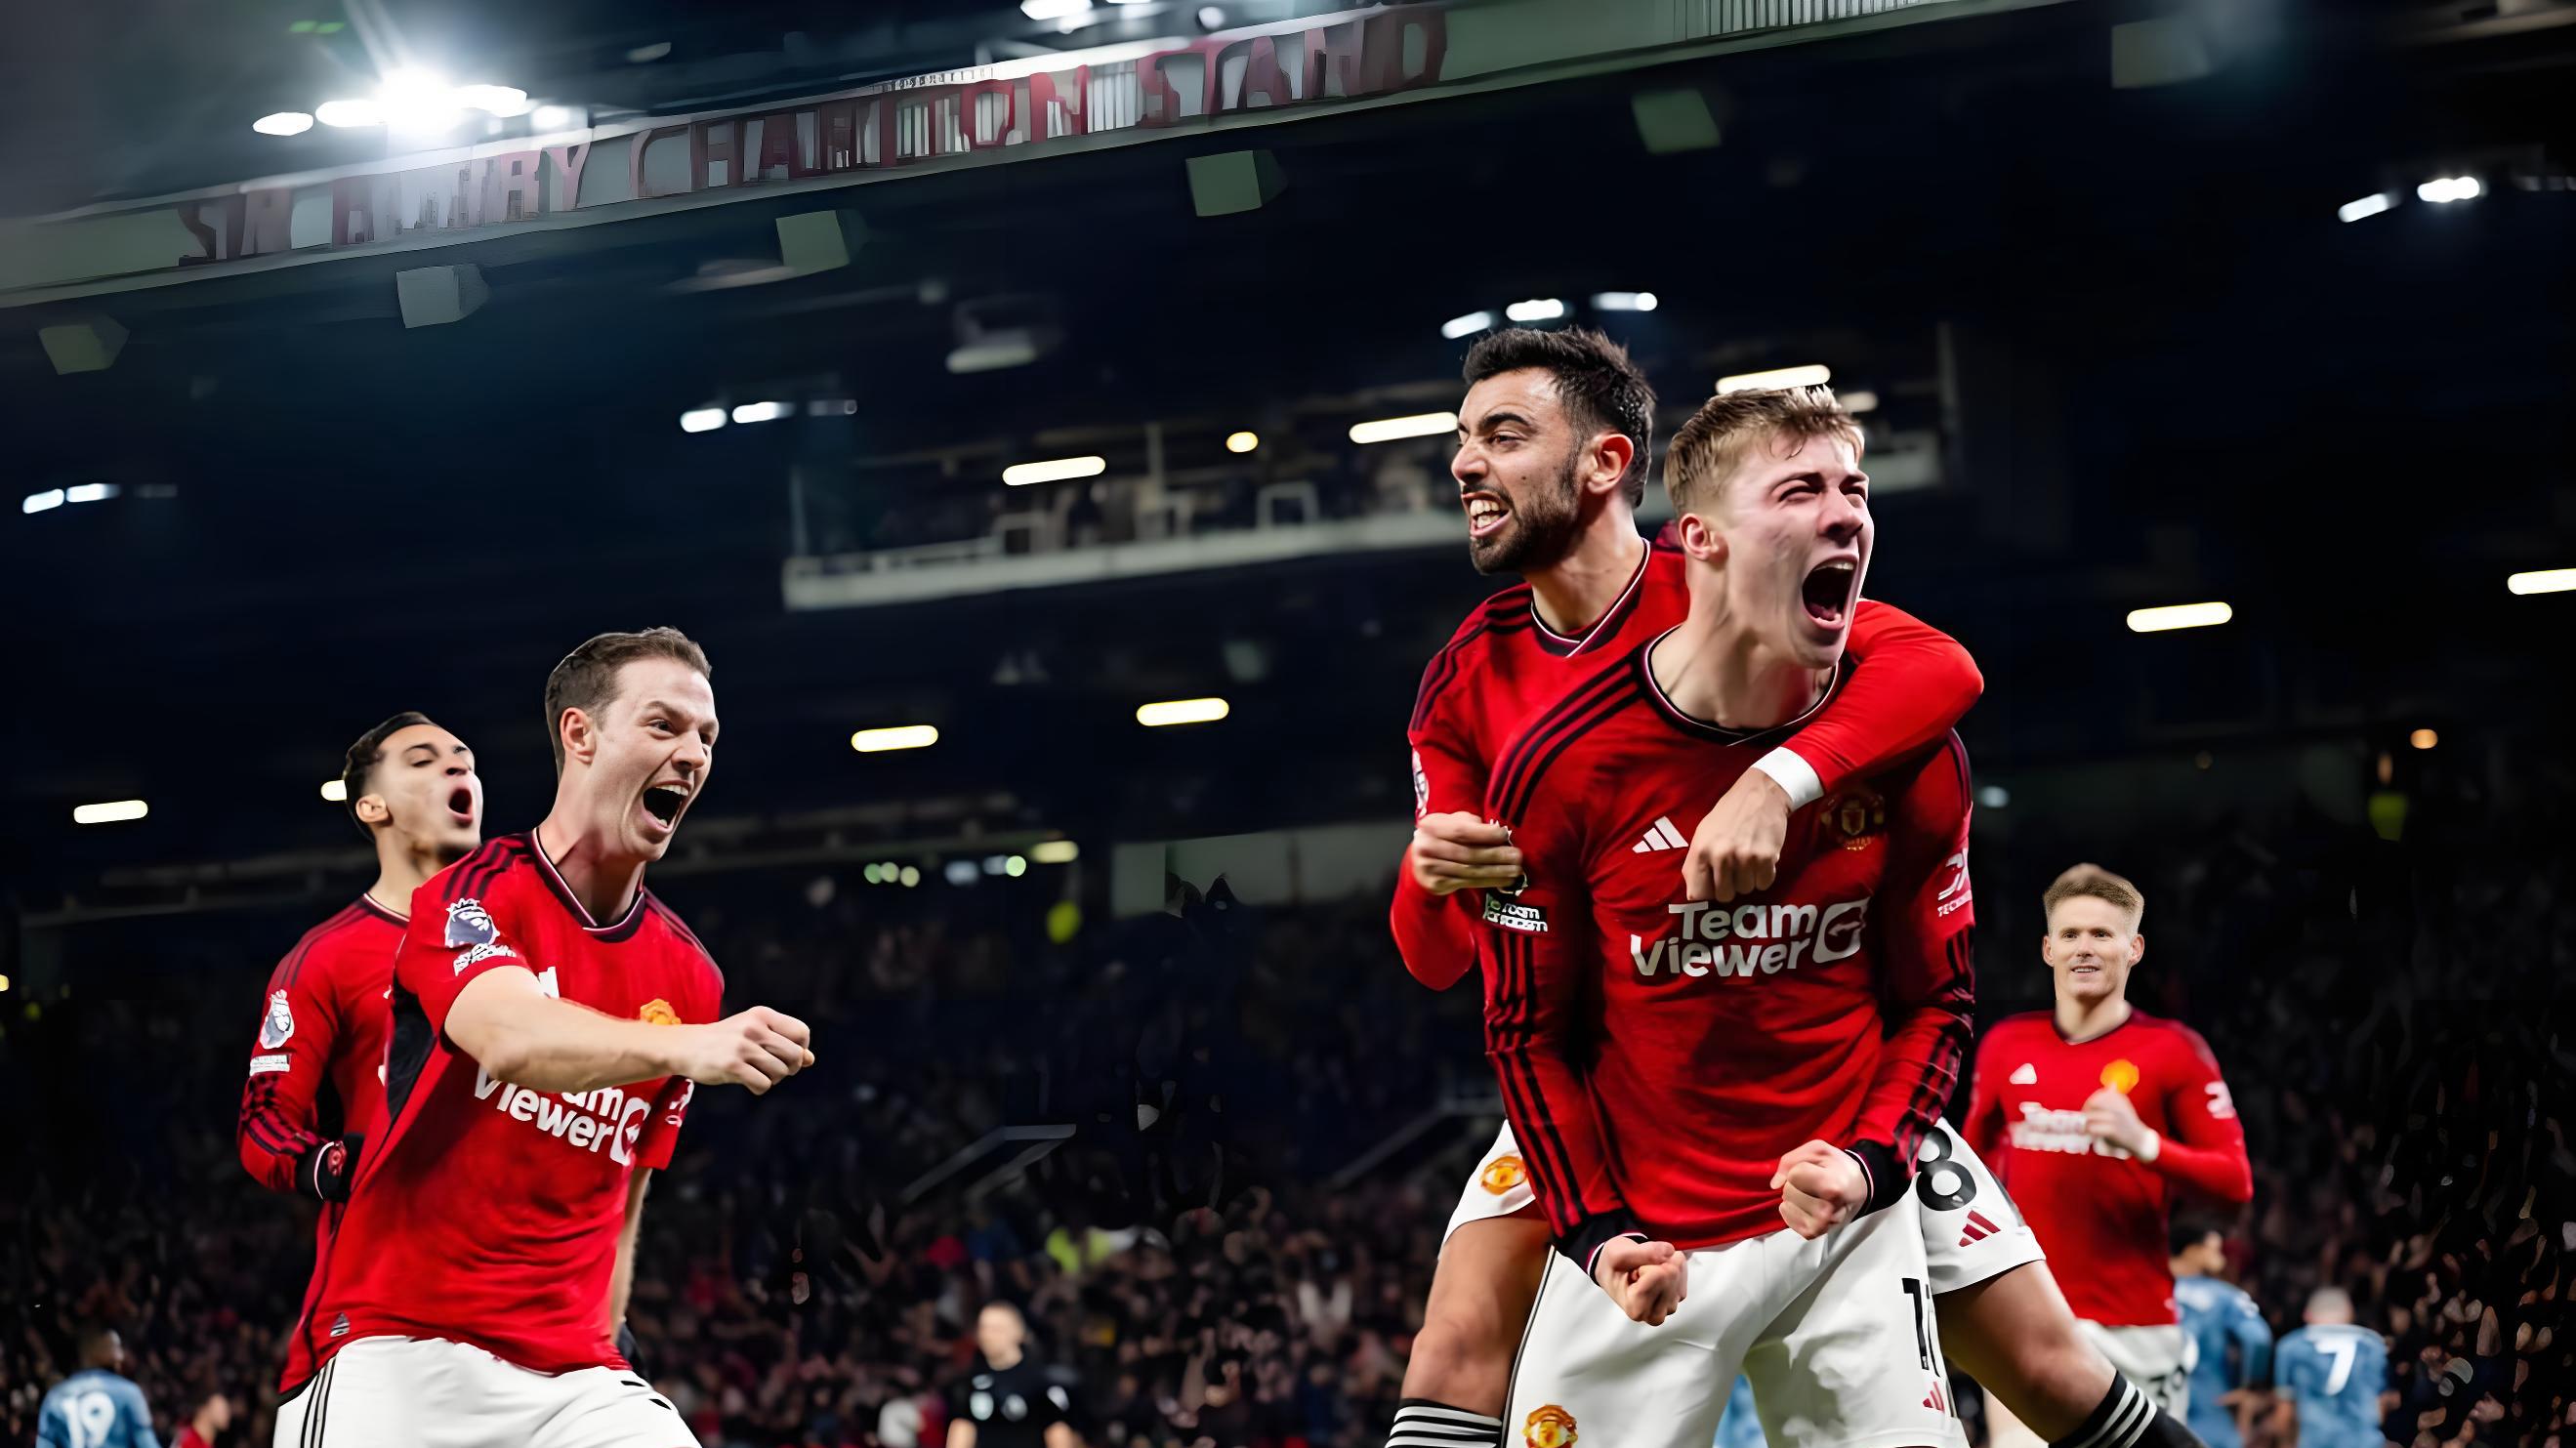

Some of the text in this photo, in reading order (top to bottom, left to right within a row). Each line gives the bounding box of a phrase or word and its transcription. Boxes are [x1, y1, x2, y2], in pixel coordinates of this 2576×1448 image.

[1668, 900, 1818, 940] Team
[1630, 933, 1810, 977] Viewer
[1916, 1126, 1977, 1211] 8
[2313, 1336, 2357, 1396] 7
[61, 1390, 116, 1448] 19
